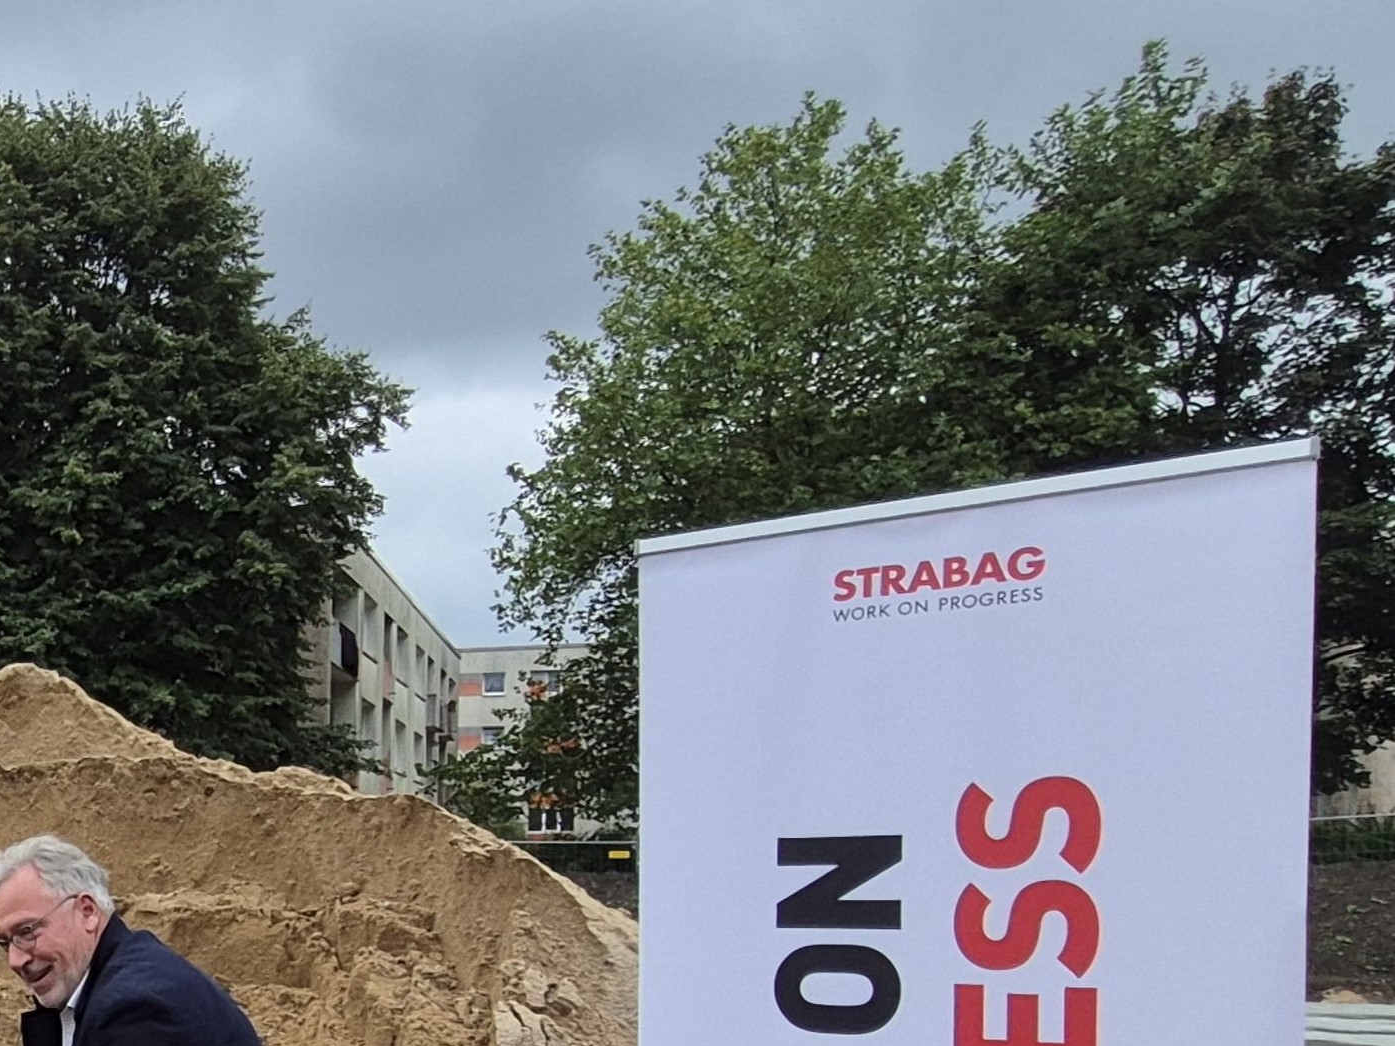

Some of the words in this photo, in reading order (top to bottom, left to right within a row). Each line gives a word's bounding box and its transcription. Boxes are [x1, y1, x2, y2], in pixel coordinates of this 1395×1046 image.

[833, 546, 1046, 602] STRABAG
[832, 604, 891, 622] WORK
[897, 600, 929, 616] ON
[938, 587, 1044, 612] PROGRESS
[774, 834, 903, 1035] ON
